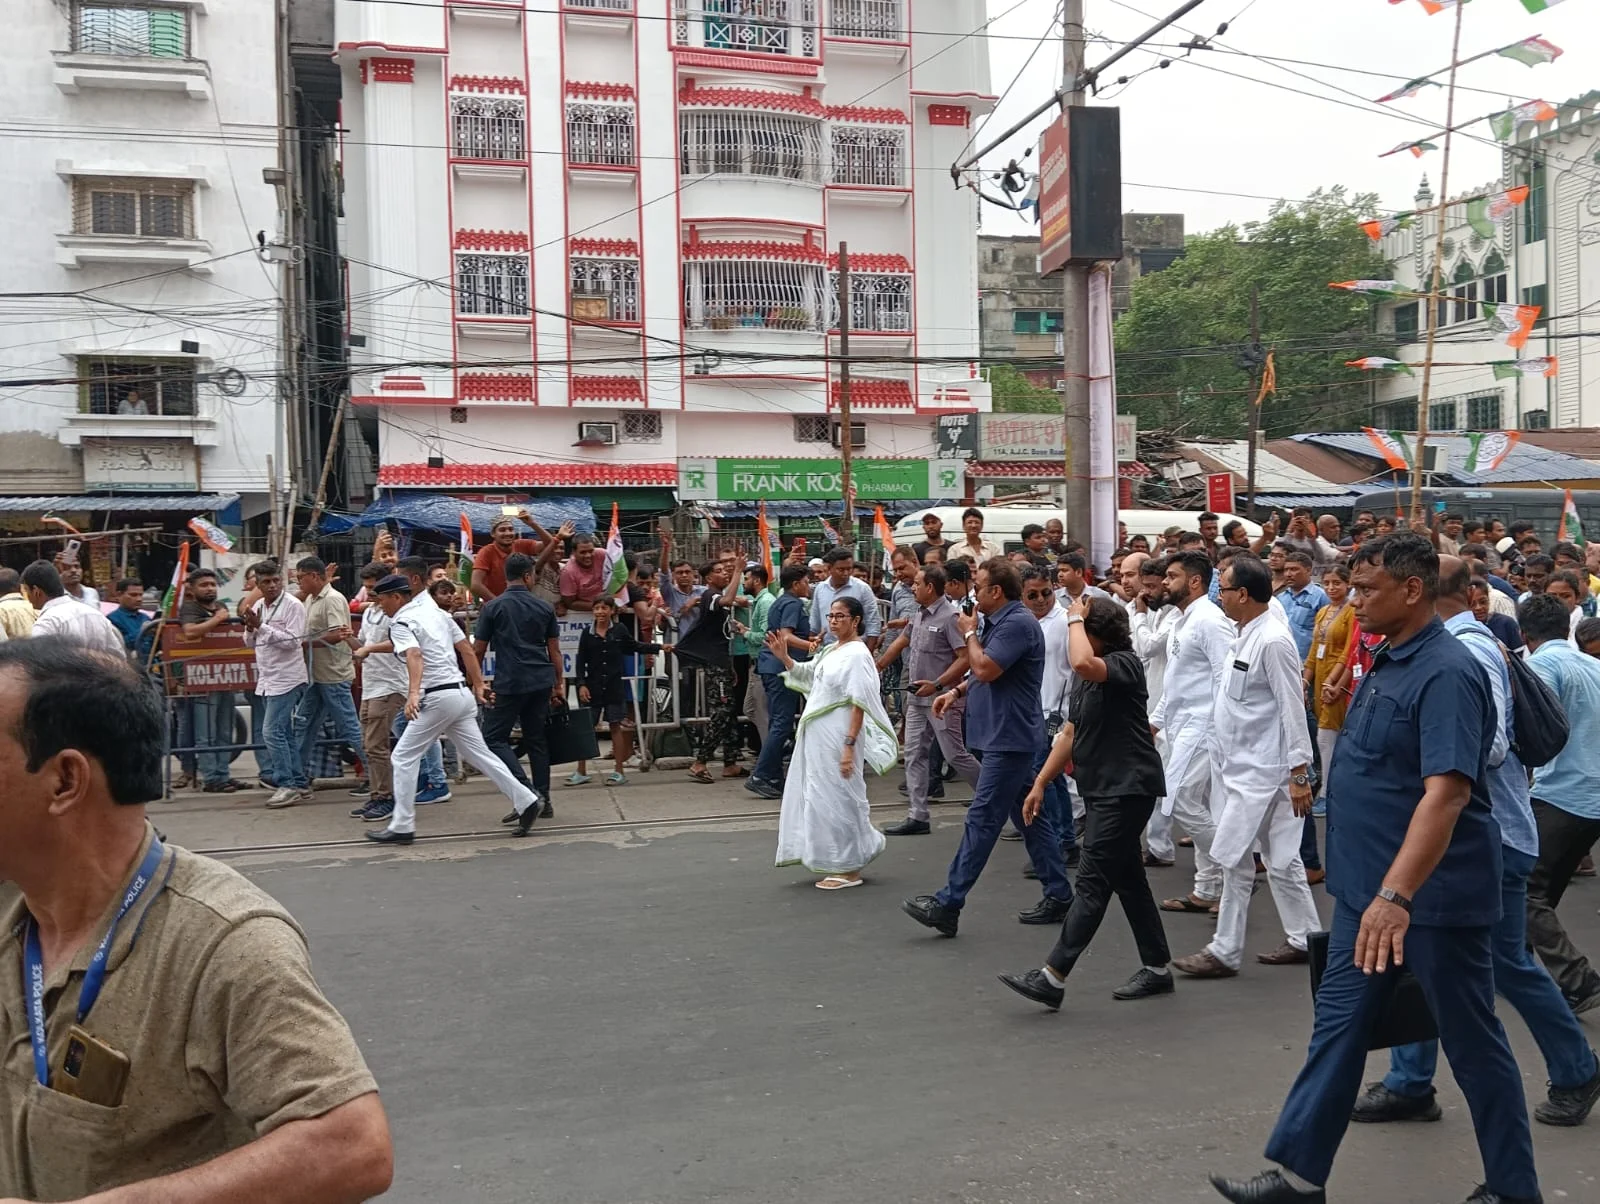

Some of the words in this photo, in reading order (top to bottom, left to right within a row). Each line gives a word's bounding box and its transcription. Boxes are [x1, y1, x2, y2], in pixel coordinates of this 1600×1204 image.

[940, 414, 970, 426] HOTEL
[987, 420, 1040, 444] HOTEL
[733, 472, 802, 492] FRANK
[862, 483, 914, 493] PHARMACY
[186, 663, 249, 686] KOLKATA
[124, 875, 147, 908] POLICE
[33, 963, 43, 998] POLICE
[35, 999, 46, 1044] KOLKATA
